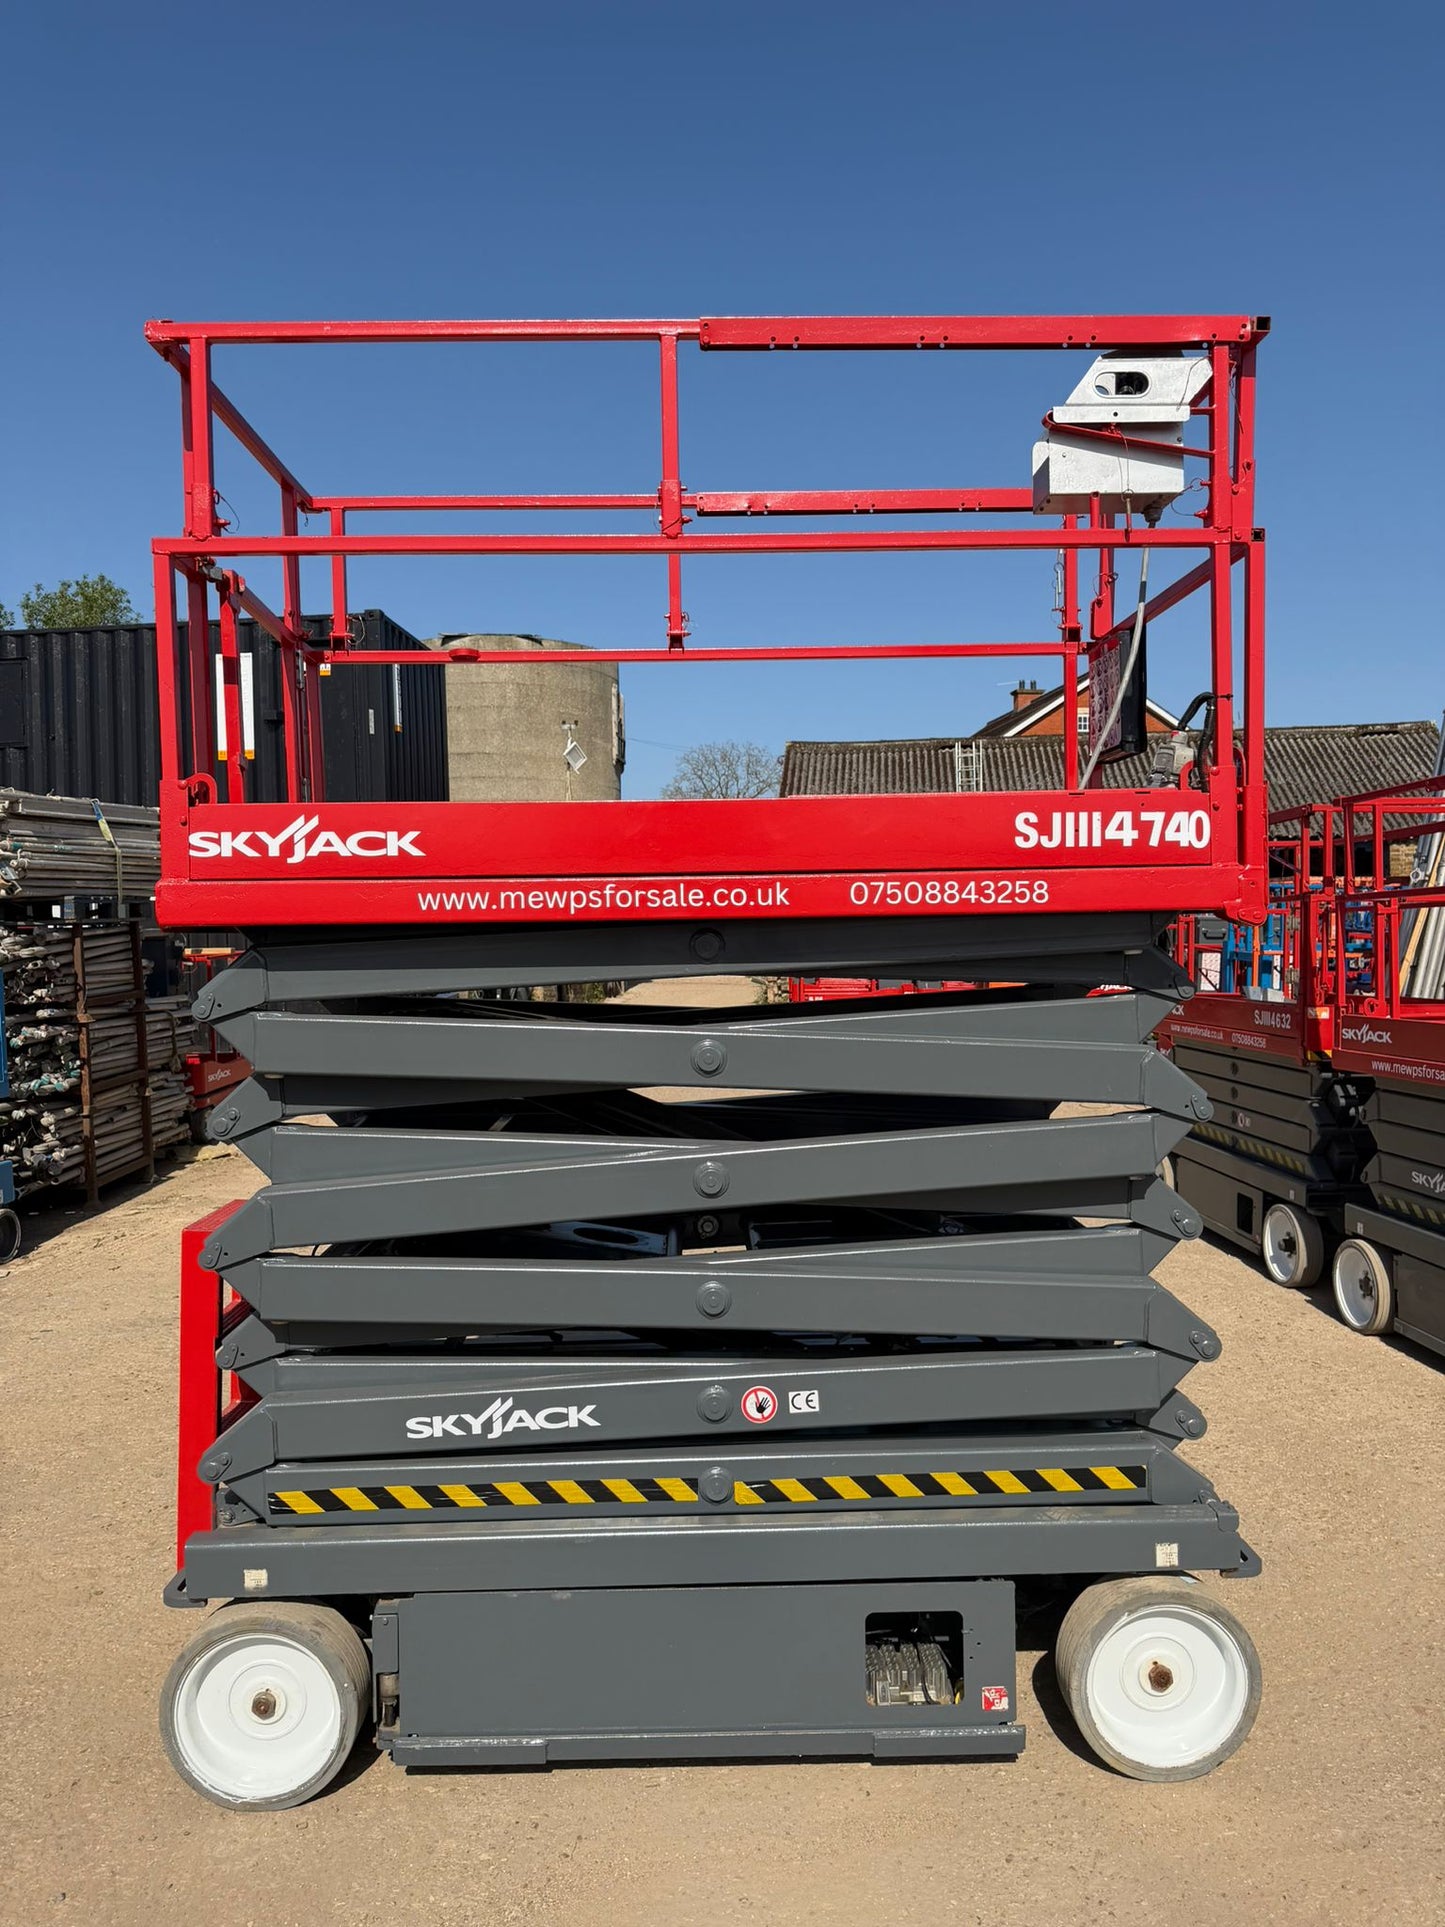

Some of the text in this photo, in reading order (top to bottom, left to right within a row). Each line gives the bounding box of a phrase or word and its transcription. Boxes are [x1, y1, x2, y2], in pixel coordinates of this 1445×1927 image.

[189, 815, 426, 864] SKYJACK
[1014, 810, 1211, 849] SJIII4740
[417, 881, 790, 915] www.mewpsforsale.co.uk
[850, 881, 1049, 905] 07508843258
[1254, 1009, 1291, 1029] SJIII4632
[1342, 1024, 1392, 1043] SKYJACK
[791, 1392, 817, 1411] CE
[406, 1396, 601, 1440] SKYJACK
